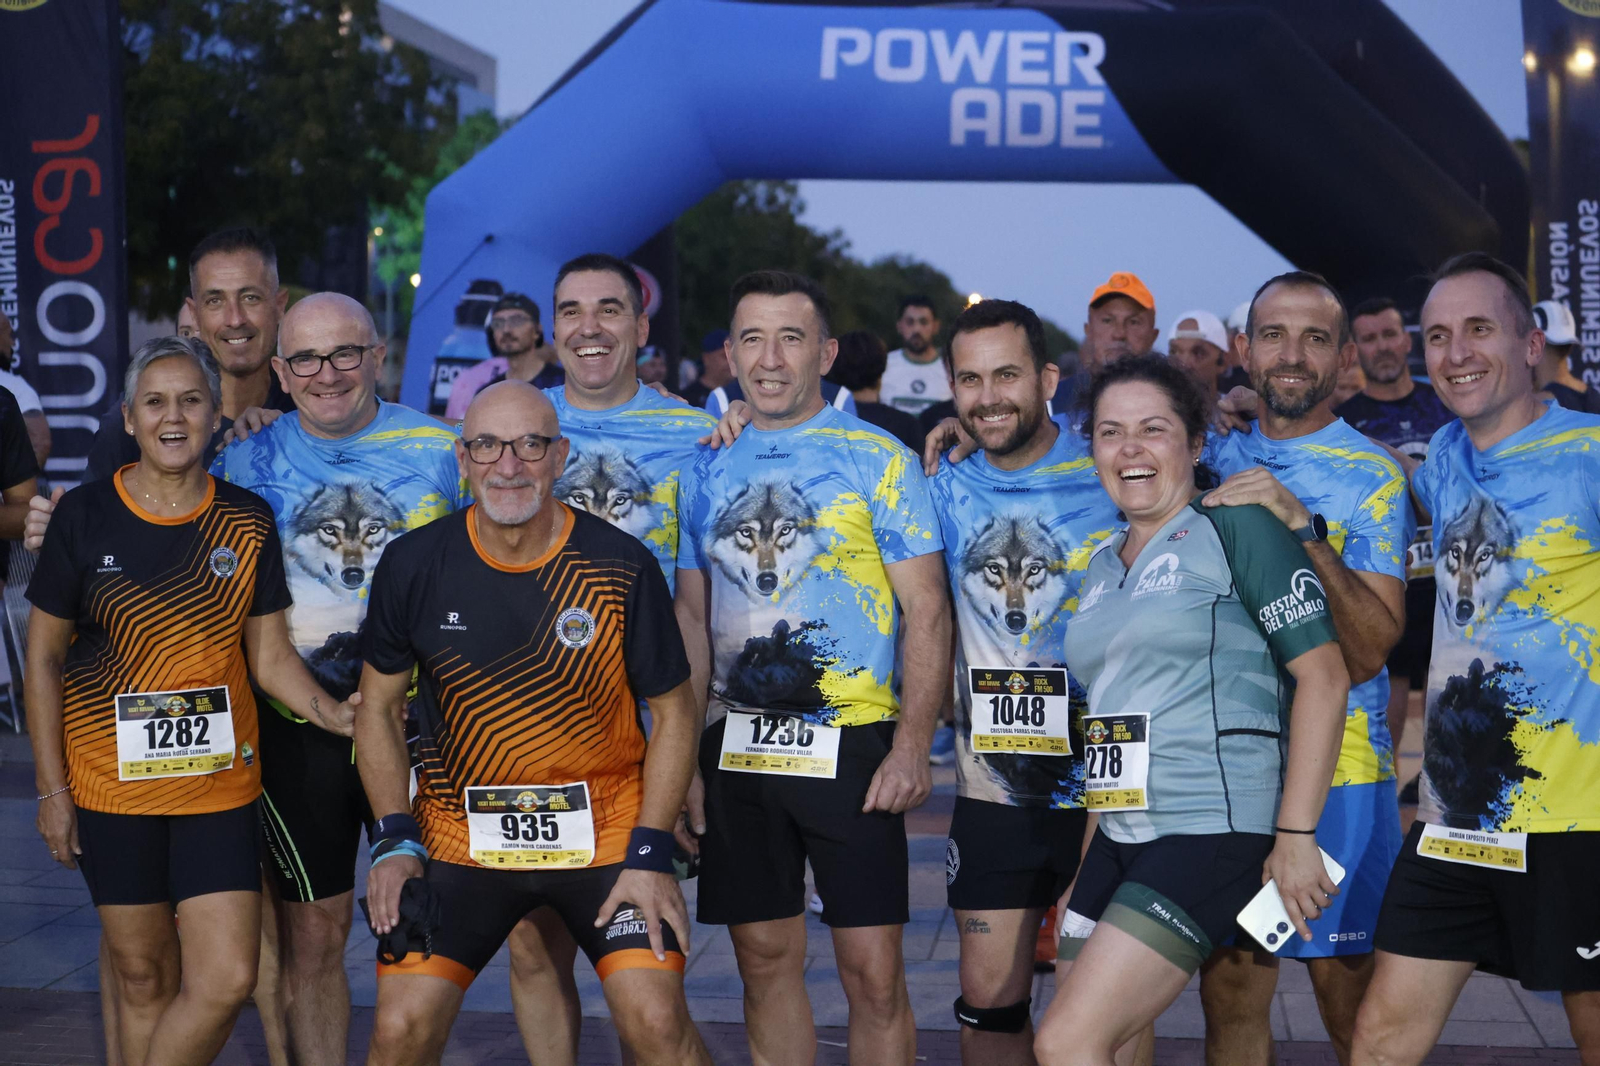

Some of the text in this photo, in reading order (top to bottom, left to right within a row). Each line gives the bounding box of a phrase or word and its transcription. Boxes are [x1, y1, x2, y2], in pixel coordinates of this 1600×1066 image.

[819, 26, 1106, 86] POWER
[949, 87, 1106, 148] ADE
[1259, 593, 1299, 622] CRESTA
[1264, 598, 1325, 635] DEL DIABLO
[1034, 685, 1044, 693] FM
[196, 704, 213, 712] MOTEL
[989, 695, 1046, 727] 1048
[143, 716, 210, 749] 1282
[750, 715, 815, 748] 1236
[1112, 724, 1127, 733] ROCK
[1113, 732, 1132, 741] FM 500
[1086, 744, 1123, 779] 278
[549, 802, 571, 810] MOTEL
[500, 814, 559, 842] 935
